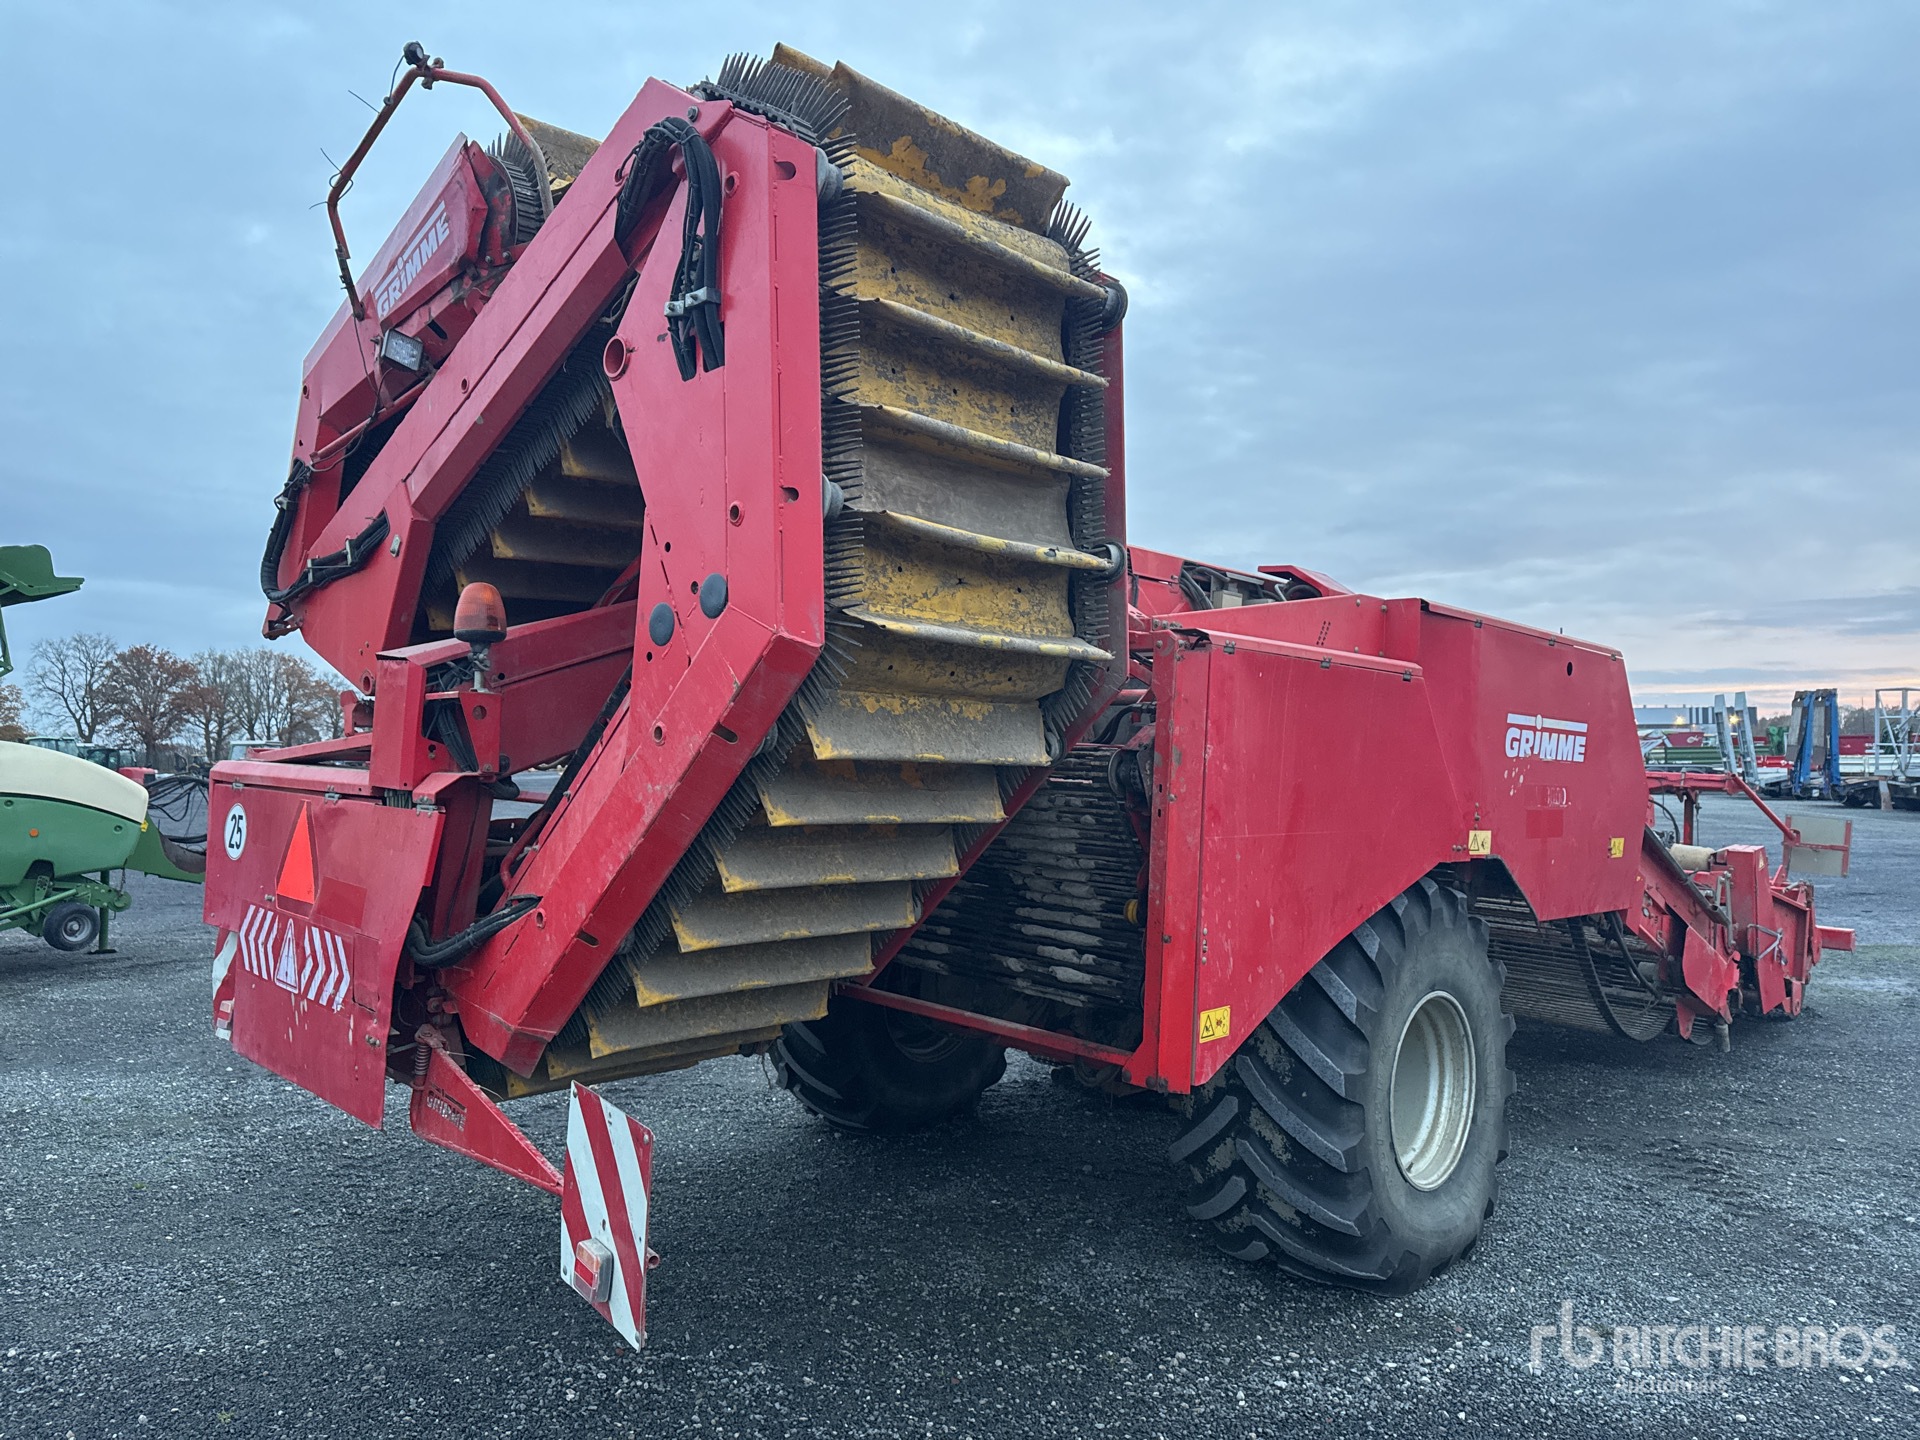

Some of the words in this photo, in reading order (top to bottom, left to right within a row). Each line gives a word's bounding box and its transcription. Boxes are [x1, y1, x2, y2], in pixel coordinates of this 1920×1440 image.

[377, 212, 450, 319] GRIMME
[1505, 727, 1586, 762] GRIMME
[229, 813, 243, 850] 25
